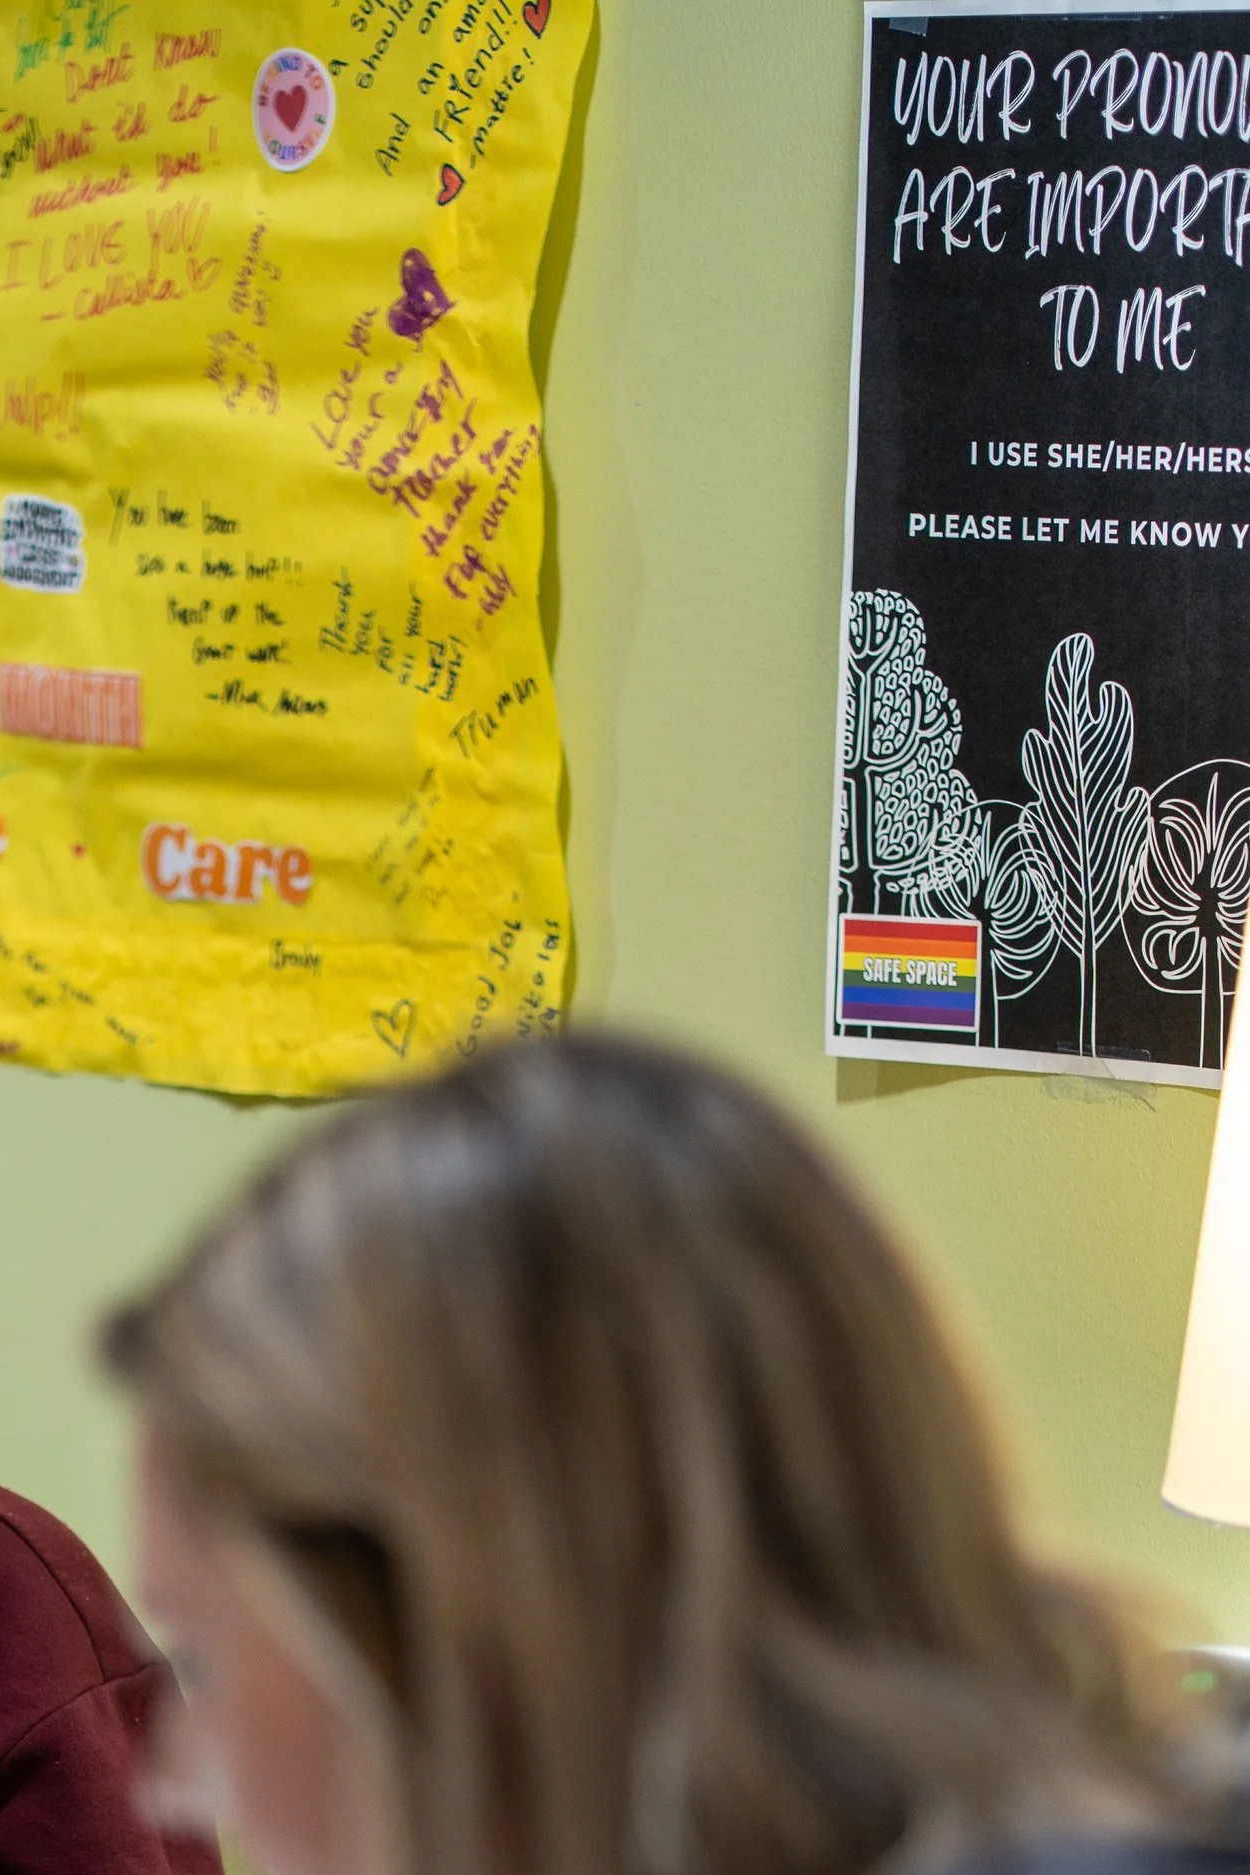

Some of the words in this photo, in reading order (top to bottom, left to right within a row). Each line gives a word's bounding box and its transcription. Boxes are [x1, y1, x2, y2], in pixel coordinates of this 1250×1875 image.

[351, 0, 387, 32] su
[304, 63, 325, 90] TO
[894, 49, 1035, 145] YOUR
[375, 112, 411, 177] And
[417, 62, 445, 95] an
[38, 219, 127, 291] LOVE
[146, 195, 211, 286] YOU
[893, 165, 1015, 264] ARE
[343, 304, 380, 357] you
[1040, 285, 1100, 371] TO
[1117, 285, 1206, 373] ME
[383, 361, 404, 384] a
[971, 441, 977, 466] I
[989, 441, 1038, 467] USE
[909, 513, 1012, 542] PLEASE
[1023, 516, 1069, 543] LET
[1080, 519, 1119, 545] ME
[1130, 520, 1222, 549] KNOW
[319, 565, 354, 653] Thank
[142, 822, 315, 905] Care
[862, 957, 902, 983] SAFE
[905, 959, 957, 987] SPACE
